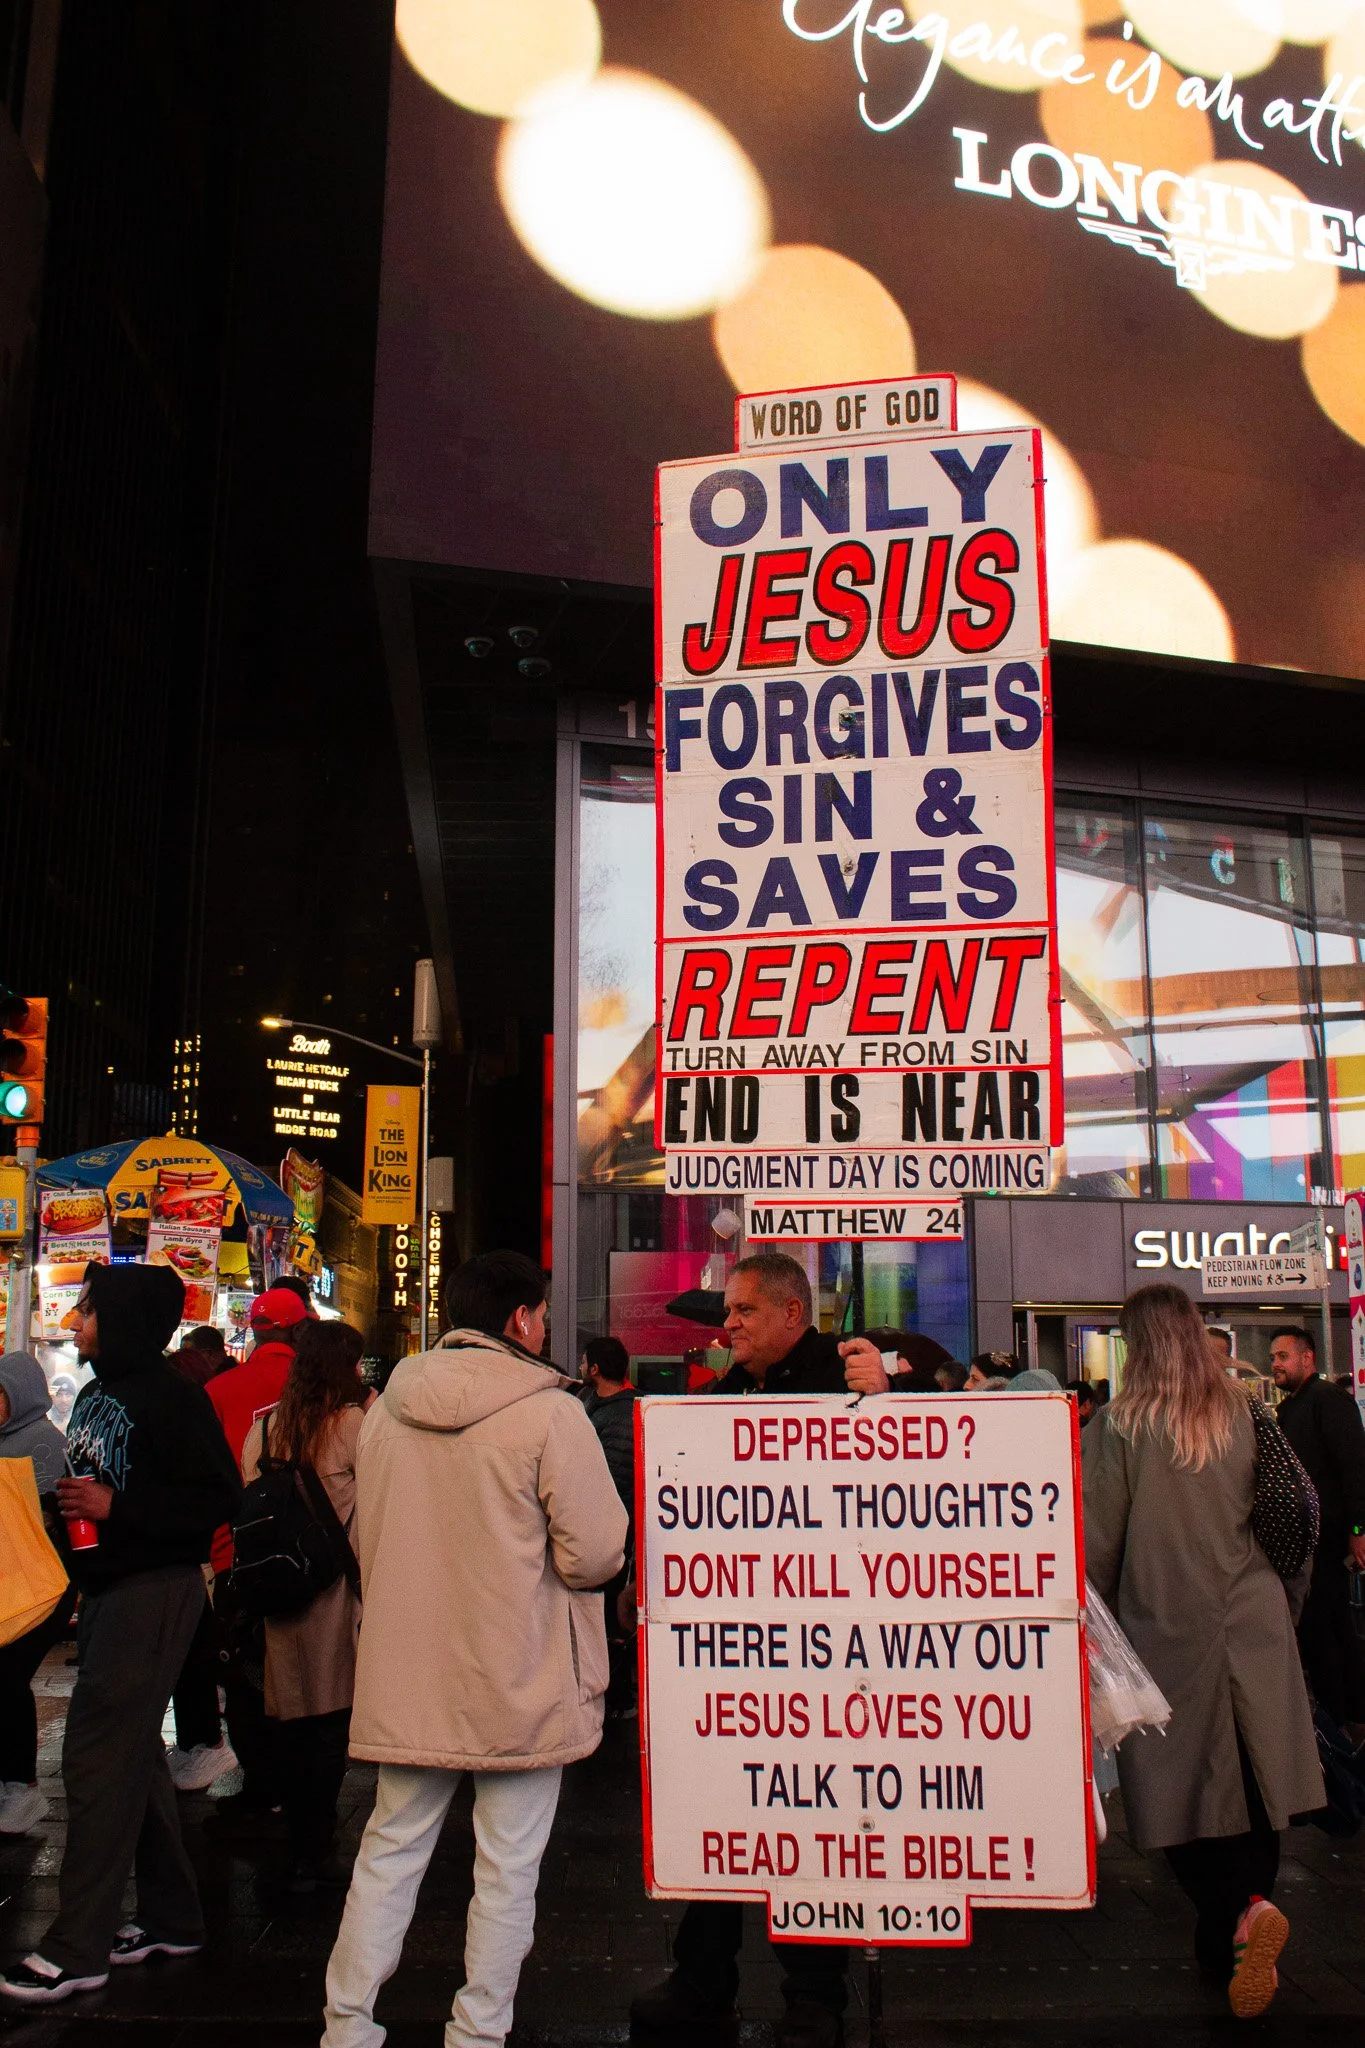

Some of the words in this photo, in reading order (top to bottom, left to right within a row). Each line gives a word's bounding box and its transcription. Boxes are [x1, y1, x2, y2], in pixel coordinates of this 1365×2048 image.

[1106, 22, 1161, 110] is
[1176, 72, 1264, 150] an
[952, 127, 1365, 273] LONGINE
[751, 400, 822, 440] WORD
[836, 394, 866, 431] OF
[886, 387, 939, 426] GOD
[689, 443, 1013, 547] ONLY
[682, 527, 1020, 676] JESUS
[665, 661, 1042, 772] FORGIVES
[718, 771, 873, 848] SIN
[916, 767, 983, 838] &
[682, 844, 1018, 932] SAVES
[666, 935, 1048, 1042] REPENT
[289, 1035, 330, 1055] Booth
[666, 1045, 746, 1071] TURN
[761, 1042, 846, 1069] AWAY
[861, 1040, 954, 1066] FROM
[970, 1039, 1028, 1064] SIN
[267, 1059, 304, 1073] LAURIE
[305, 1063, 350, 1078] METCALF
[307, 1079, 339, 1092] STOCK
[273, 1107, 310, 1120] LITTLE
[313, 1111, 341, 1123] BEAR
[665, 1075, 760, 1144] END
[804, 1073, 861, 1144] IS
[902, 1071, 1041, 1142] NEAR
[275, 1123, 307, 1136] RIDGE
[309, 1126, 338, 1138] ROAD
[379, 1128, 404, 1141] THE
[135, 1157, 212, 1172] SABRETT
[374, 1146, 407, 1167] LION
[669, 1155, 819, 1189] JUDGMENT
[828, 1154, 886, 1189] DAY
[894, 1154, 920, 1189] IS
[929, 1153, 1045, 1189] COMING
[368, 1169, 411, 1192] KING
[159, 1223, 181, 1231] Italian
[182, 1225, 211, 1234] Sausage
[751, 1207, 907, 1234] MATTHEW
[926, 1207, 962, 1233] 24
[163, 1235, 184, 1243] Lamb
[1206, 1260, 1258, 1273] PEDESTRIAN
[1259, 1258, 1282, 1271] FLOW
[1284, 1257, 1306, 1270] ZONE
[1207, 1276, 1228, 1288] KEEP
[1231, 1274, 1263, 1287] MOVING
[42, 1291, 63, 1299] Corn
[733, 1414, 977, 1462] DEPRESSED?
[657, 1484, 823, 1530] SUICIDAL
[832, 1481, 1060, 1530] THOUGHTS?
[664, 1553, 761, 1599] DONT
[773, 1553, 850, 1598] KILL
[861, 1552, 1056, 1599] YOURSELF
[671, 1623, 789, 1669] THERE
[801, 1623, 833, 1669] IS
[845, 1623, 869, 1669] A
[879, 1623, 961, 1669] WAY
[975, 1623, 1050, 1670] OUT
[695, 1692, 811, 1739] JESUS
[823, 1693, 944, 1740] LOVES
[954, 1694, 1032, 1741] YOU
[743, 1762, 838, 1808] TALK
[853, 1763, 903, 1810] TO
[920, 1765, 984, 1810] HIM
[702, 1831, 801, 1877] READ
[815, 1833, 887, 1880] THE
[904, 1835, 1036, 1882] BIBLE!
[772, 1901, 865, 1930] JOHN
[877, 1904, 962, 1933] 10:10
